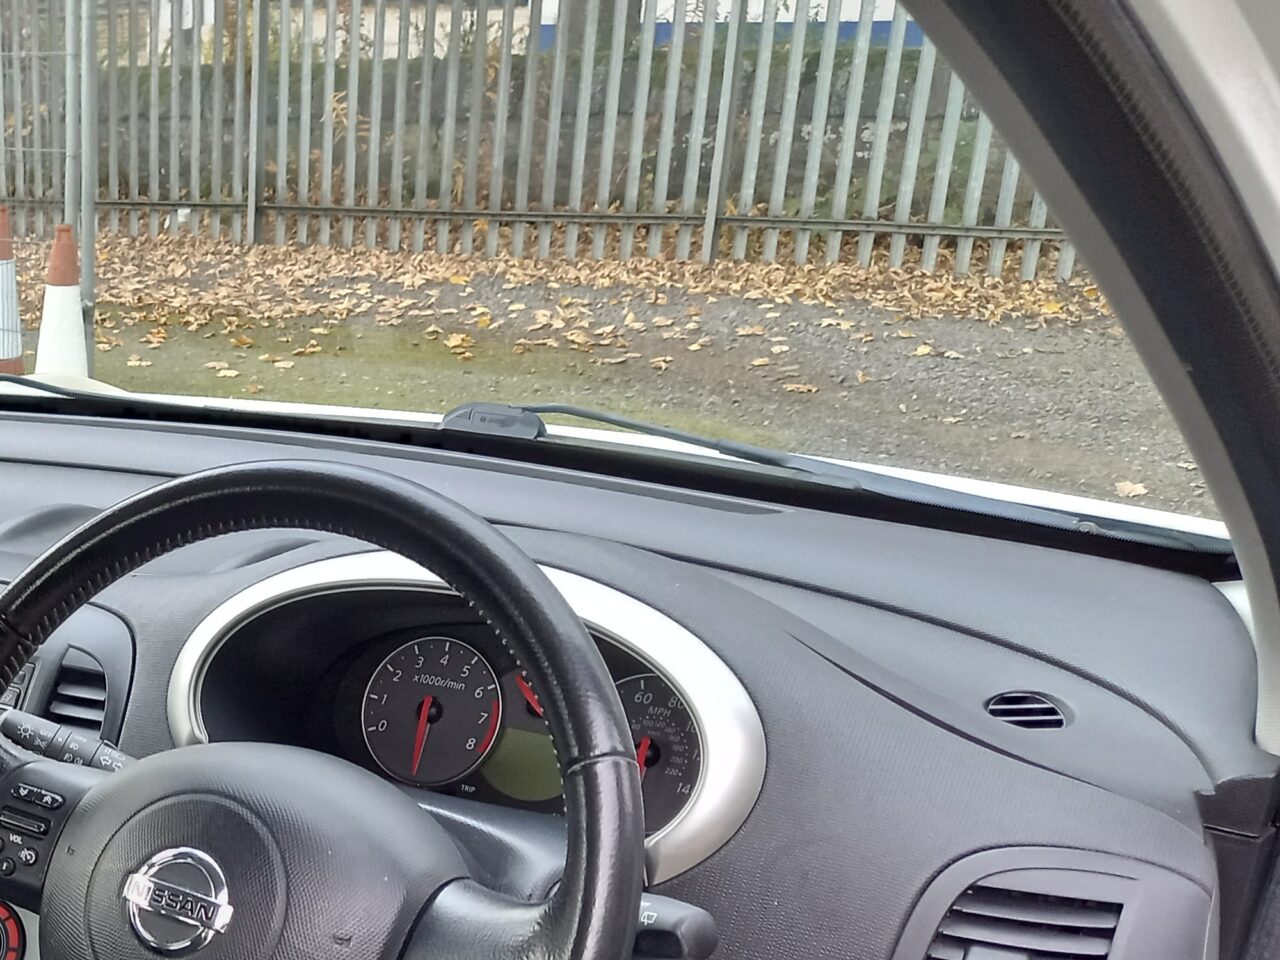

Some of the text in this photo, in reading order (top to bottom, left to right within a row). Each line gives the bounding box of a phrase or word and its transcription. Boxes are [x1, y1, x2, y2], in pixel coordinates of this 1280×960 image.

[414, 656, 424, 668] 3
[439, 654, 449, 666] 4
[393, 670, 402, 682] 2
[460, 665, 471, 677] 5
[412, 673, 465, 691] x1000r/min
[474, 686, 484, 699] 6
[634, 691, 653, 704] 60
[381, 694, 388, 705] 1
[648, 706, 671, 717] MPH
[478, 712, 488, 724] 7
[378, 719, 388, 731] 0
[686, 721, 698, 734] 10
[465, 737, 476, 750] 8
[461, 784, 476, 793] TRIP
[676, 782, 693, 795] 14
[9, 833, 23, 845] VOL
[131, 879, 217, 923] NISSAN
